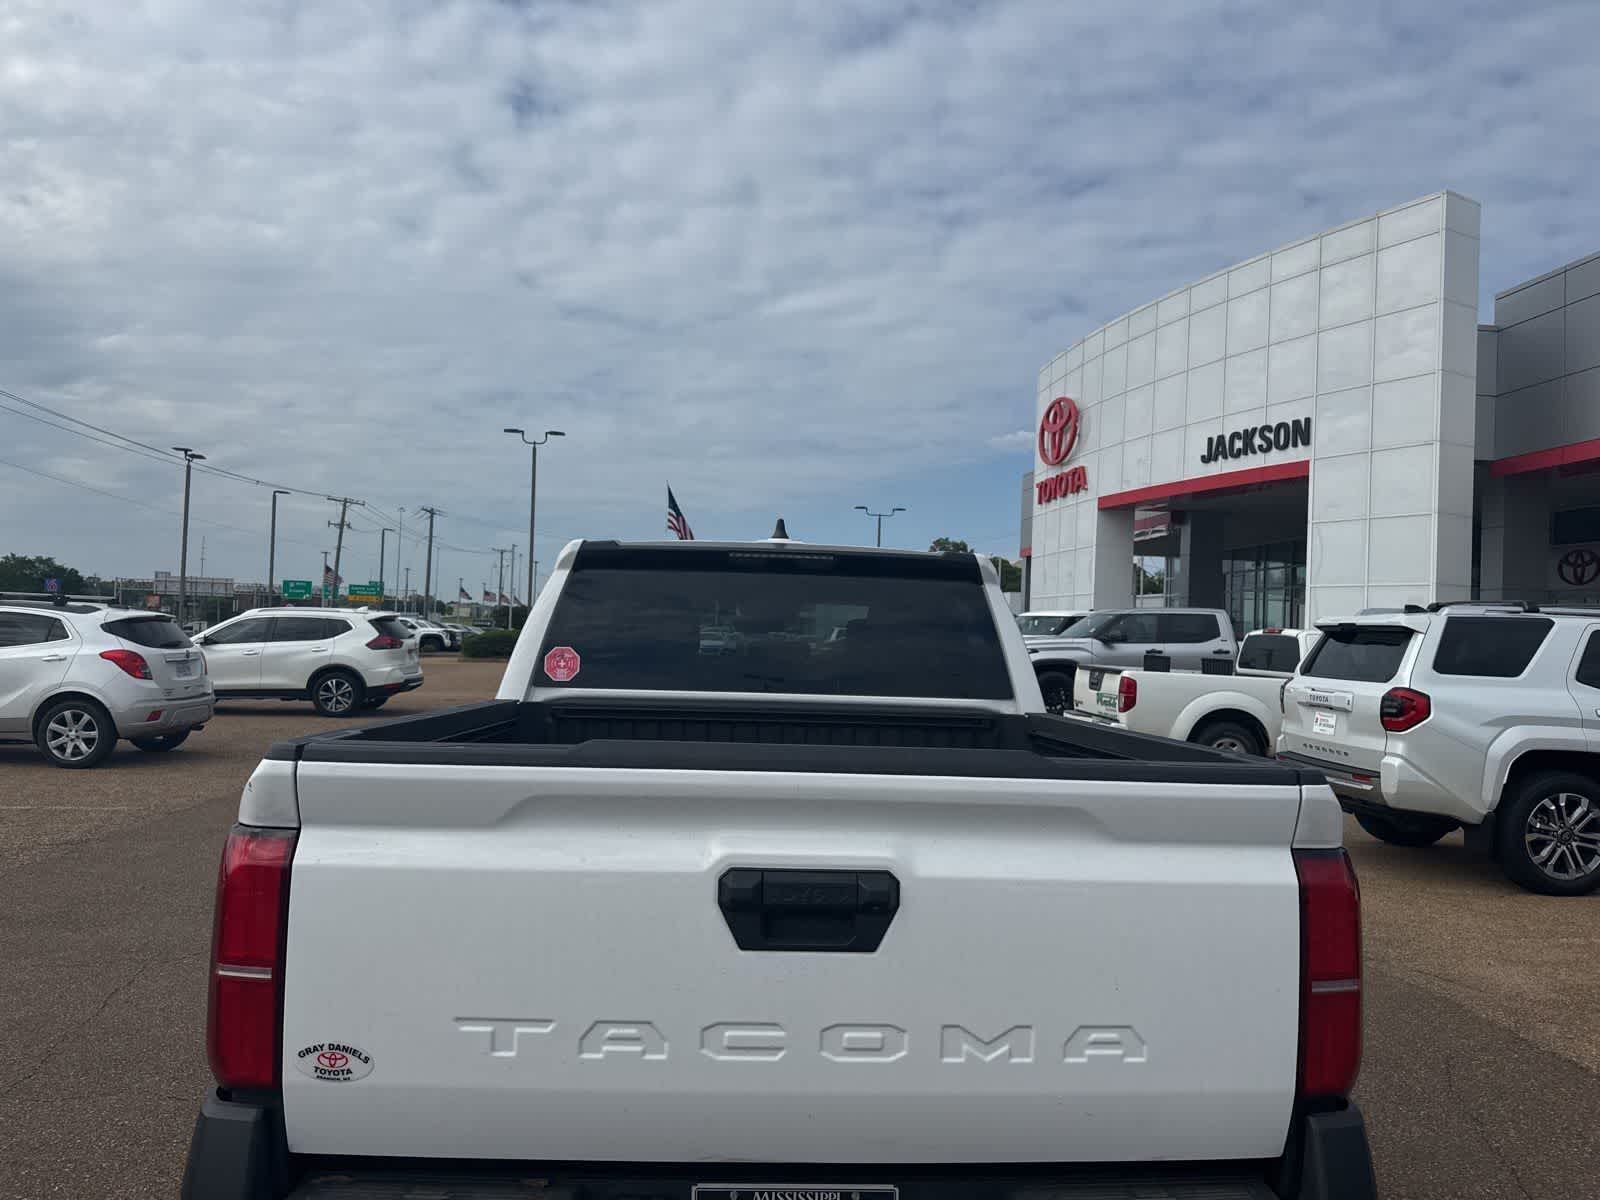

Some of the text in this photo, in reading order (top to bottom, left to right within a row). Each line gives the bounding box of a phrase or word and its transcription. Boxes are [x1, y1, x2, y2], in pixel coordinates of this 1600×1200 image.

[1200, 416, 1311, 464] JACKSON
[1036, 465, 1088, 505] TOYOTA
[1308, 694, 1329, 703] TOYOTA
[298, 1043, 370, 1064] GRAY DANIELS
[452, 1016, 1149, 1064] TACOMA
[314, 1066, 353, 1077] TOYOTA
